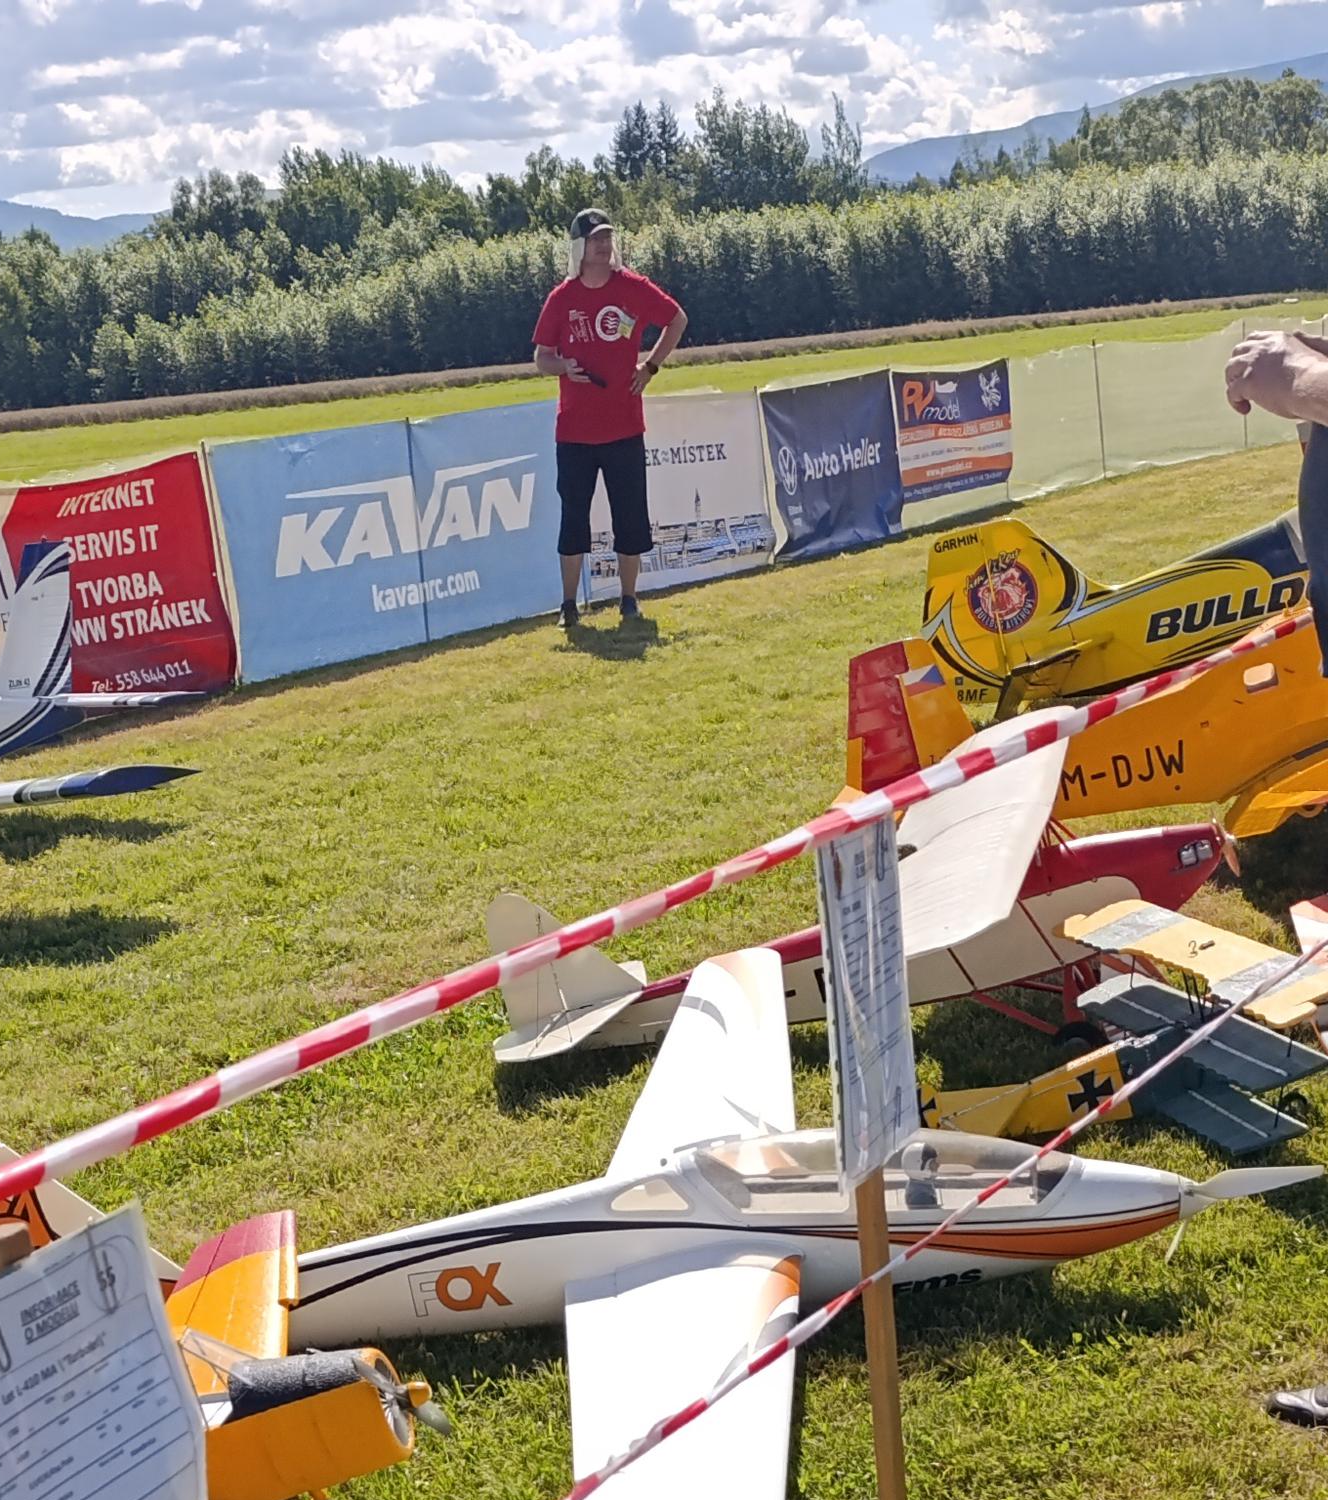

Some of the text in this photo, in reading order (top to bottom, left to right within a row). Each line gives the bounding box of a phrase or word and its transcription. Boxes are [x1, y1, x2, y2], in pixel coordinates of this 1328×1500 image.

[804, 454, 840, 481] Auto
[842, 440, 881, 471] Heller
[56, 478, 154, 518] INTERNET
[275, 453, 538, 578] KAVAN
[63, 524, 159, 564] SERVIS IT
[934, 532, 979, 554] GARMIN
[76, 571, 164, 608] TVORBA
[372, 569, 480, 613] kavanrc.com
[1147, 575, 1307, 643] BULLD
[70, 599, 213, 647] WW STRÁNEK
[91, 659, 193, 693] Tel: 558 644 011
[957, 688, 989, 702] 8MF
[1060, 739, 1184, 801] M-DJW
[20, 1280, 80, 1326] INFORMACE
[407, 1262, 513, 1317] FOX
[35, 1300, 79, 1338] MODELU
